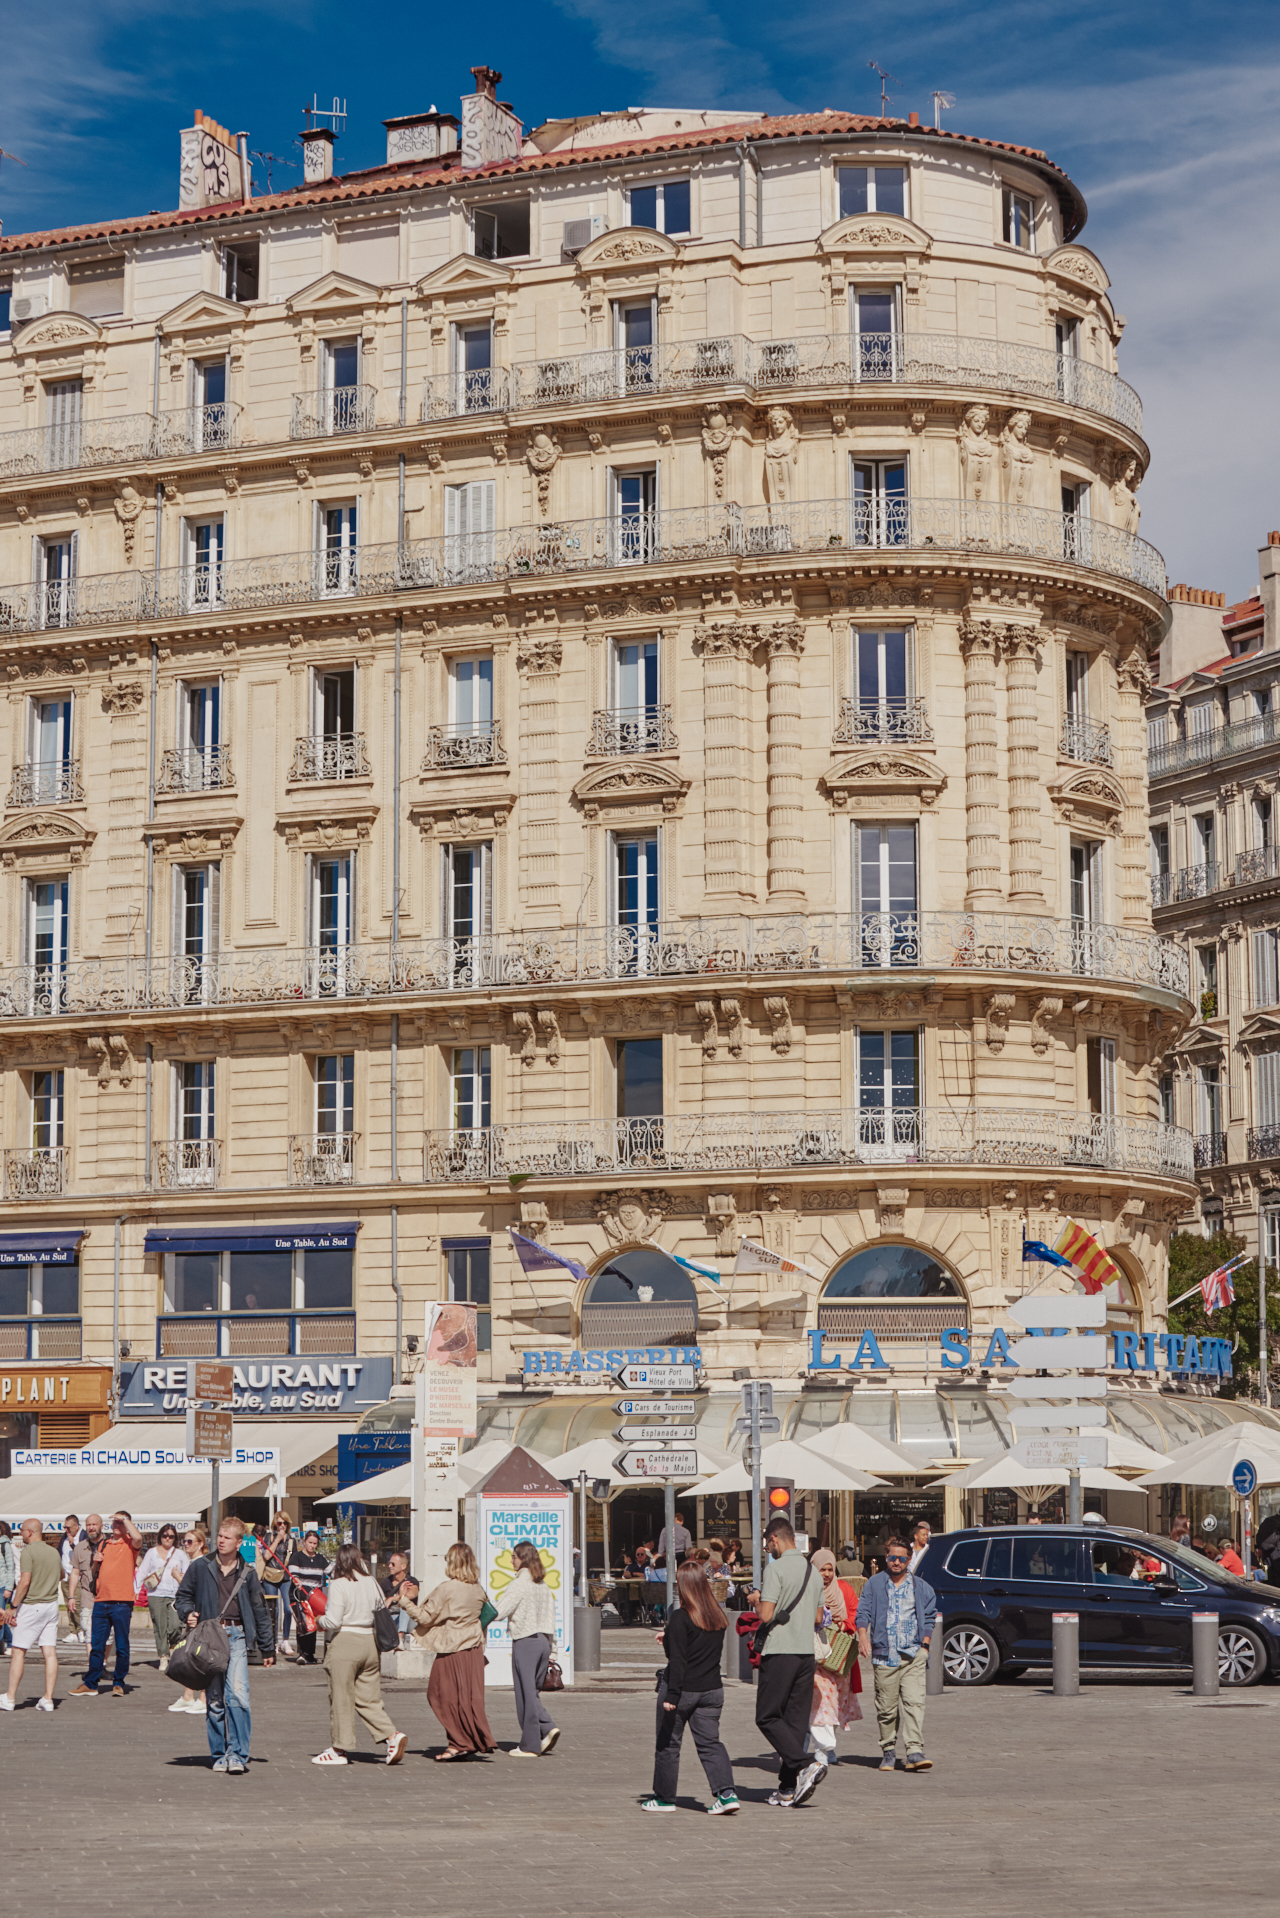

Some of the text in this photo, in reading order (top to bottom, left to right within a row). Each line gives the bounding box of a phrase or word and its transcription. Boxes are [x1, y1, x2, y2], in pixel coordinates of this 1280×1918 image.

[275, 1238, 348, 1248] Une Table, Au Sud
[0, 1252, 67, 1262] Une Table, Au Sud
[758, 1256, 779, 1265] SUD
[808, 1329, 890, 1369] LA
[144, 1364, 362, 1390] REAURANT
[649, 1378, 666, 1386] Hôtel
[2, 1377, 70, 1400] PLANT
[270, 1395, 297, 1407] au
[300, 1391, 343, 1408] Sud
[641, 1429, 678, 1438] Esplanade
[348, 1437, 371, 1451] Une
[373, 1436, 402, 1450] Table
[236, 1450, 273, 1463] SHOP
[363, 1461, 394, 1474] Ludovi
[674, 1464, 694, 1473] Major
[492, 1512, 558, 1523] Marseille
[490, 1524, 561, 1535] CLIMAT
